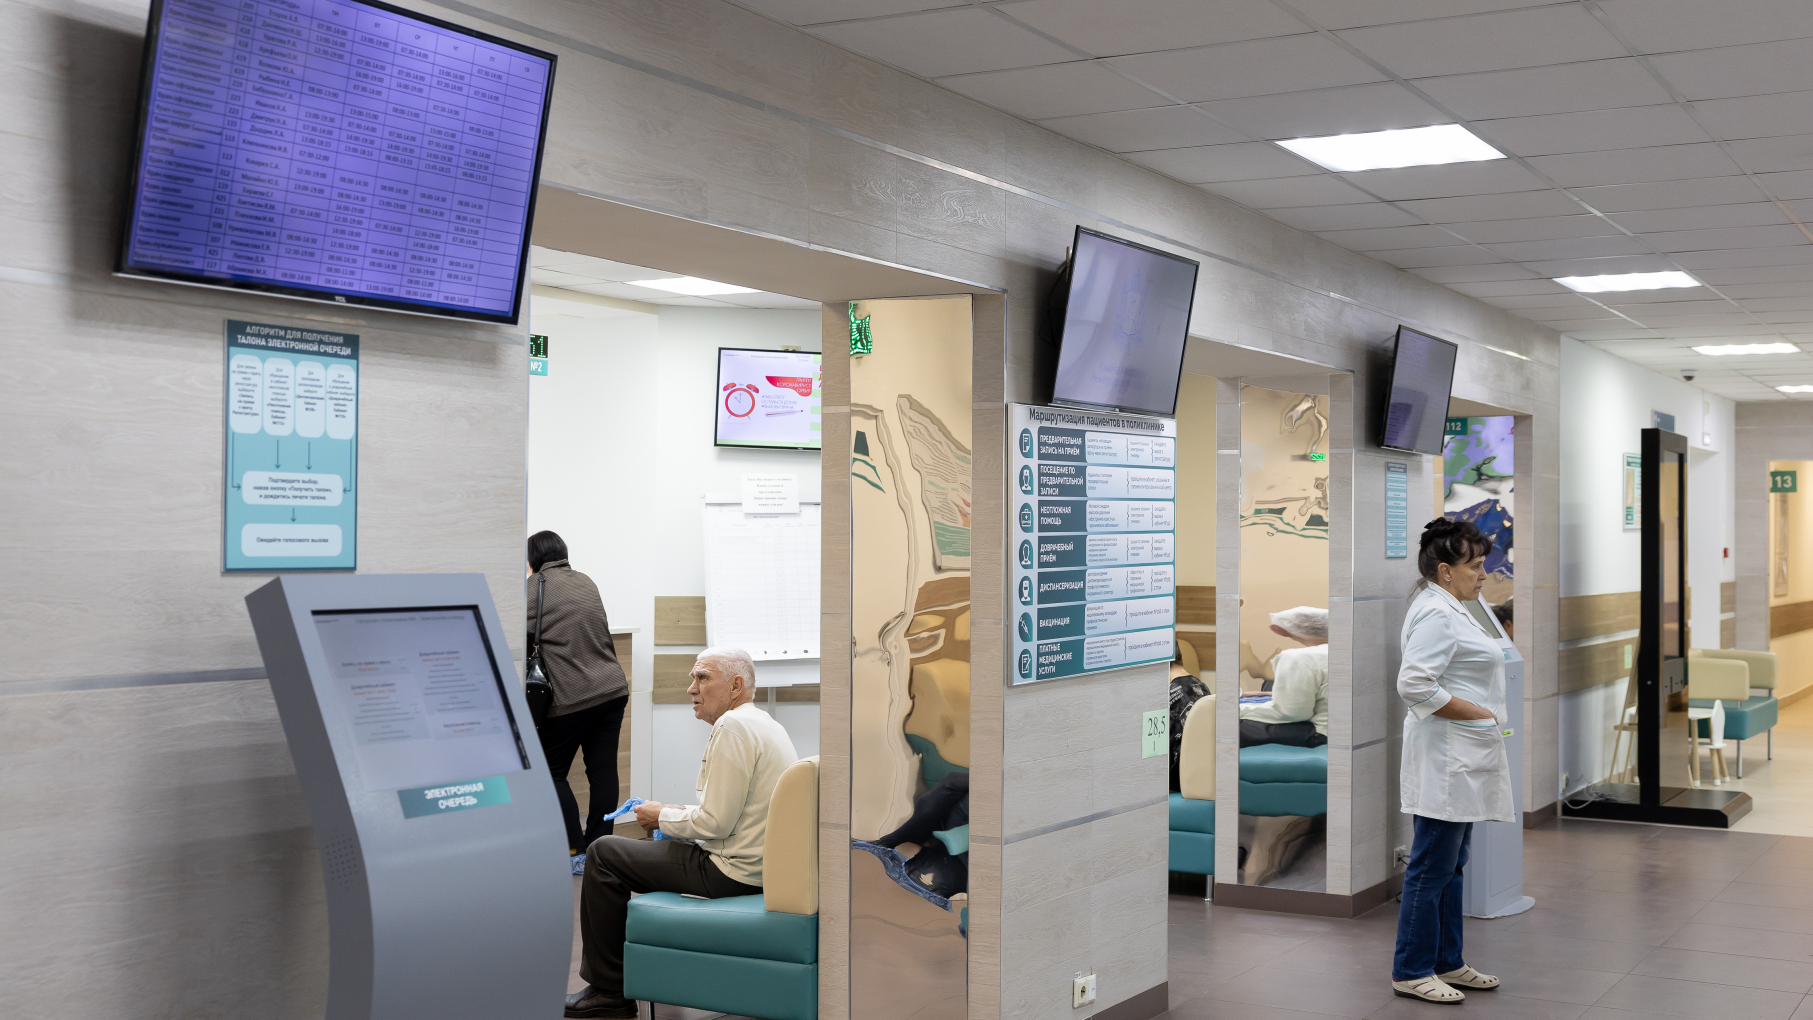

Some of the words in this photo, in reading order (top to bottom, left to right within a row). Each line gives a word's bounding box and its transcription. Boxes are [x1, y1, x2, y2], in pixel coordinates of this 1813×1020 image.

[246, 326, 285, 337] АЛГОРИТМ
[286, 330, 300, 340] ДЛЯ
[302, 332, 344, 344] ПОЛУЧЕНИЯ
[237, 335, 266, 346] ТАЛОНА
[267, 338, 318, 351] ЭЛЕКТРОННОЙ
[320, 344, 352, 355] ОЧЕРЕДИ
[1030, 408, 1085, 426] Маршрутизация
[1086, 416, 1121, 427] пациентов
[1126, 421, 1165, 432] поликлинике
[1446, 422, 1462, 430] 112
[1040, 435, 1082, 445] ПРЕДВАРИТЕЛЬНАЯ
[1040, 446, 1057, 455] ЗАПИСЬ
[1064, 446, 1080, 456] ПРИЁМ
[1040, 466, 1069, 475] ПОСЕЩЕНИЕ
[1040, 476, 1083, 485] ПРЕДВАРИТЕЛЬНОЙ
[1040, 517, 1061, 526] ПОМОЩЬ
[1040, 542, 1074, 553] ДОВРАЧЕБНЫЙ
[1040, 553, 1056, 562] ПРИЁМ
[1040, 581, 1083, 592] ДИСПАНСЕРИЗАЦИЯ
[1040, 616, 1070, 628] ВАКЦИНАЦИЯ
[1040, 643, 1060, 653] ПЛАТНЫЕ
[1039, 652, 1072, 664] МЕДИЦИНСКИЕ
[1039, 666, 1055, 675] УСЛУГИ
[1148, 716, 1166, 738] 28,5
[424, 782, 484, 799] ЭЛЕКТРОННАЯ
[438, 795, 478, 809] ОЧЕРЕДЬ
